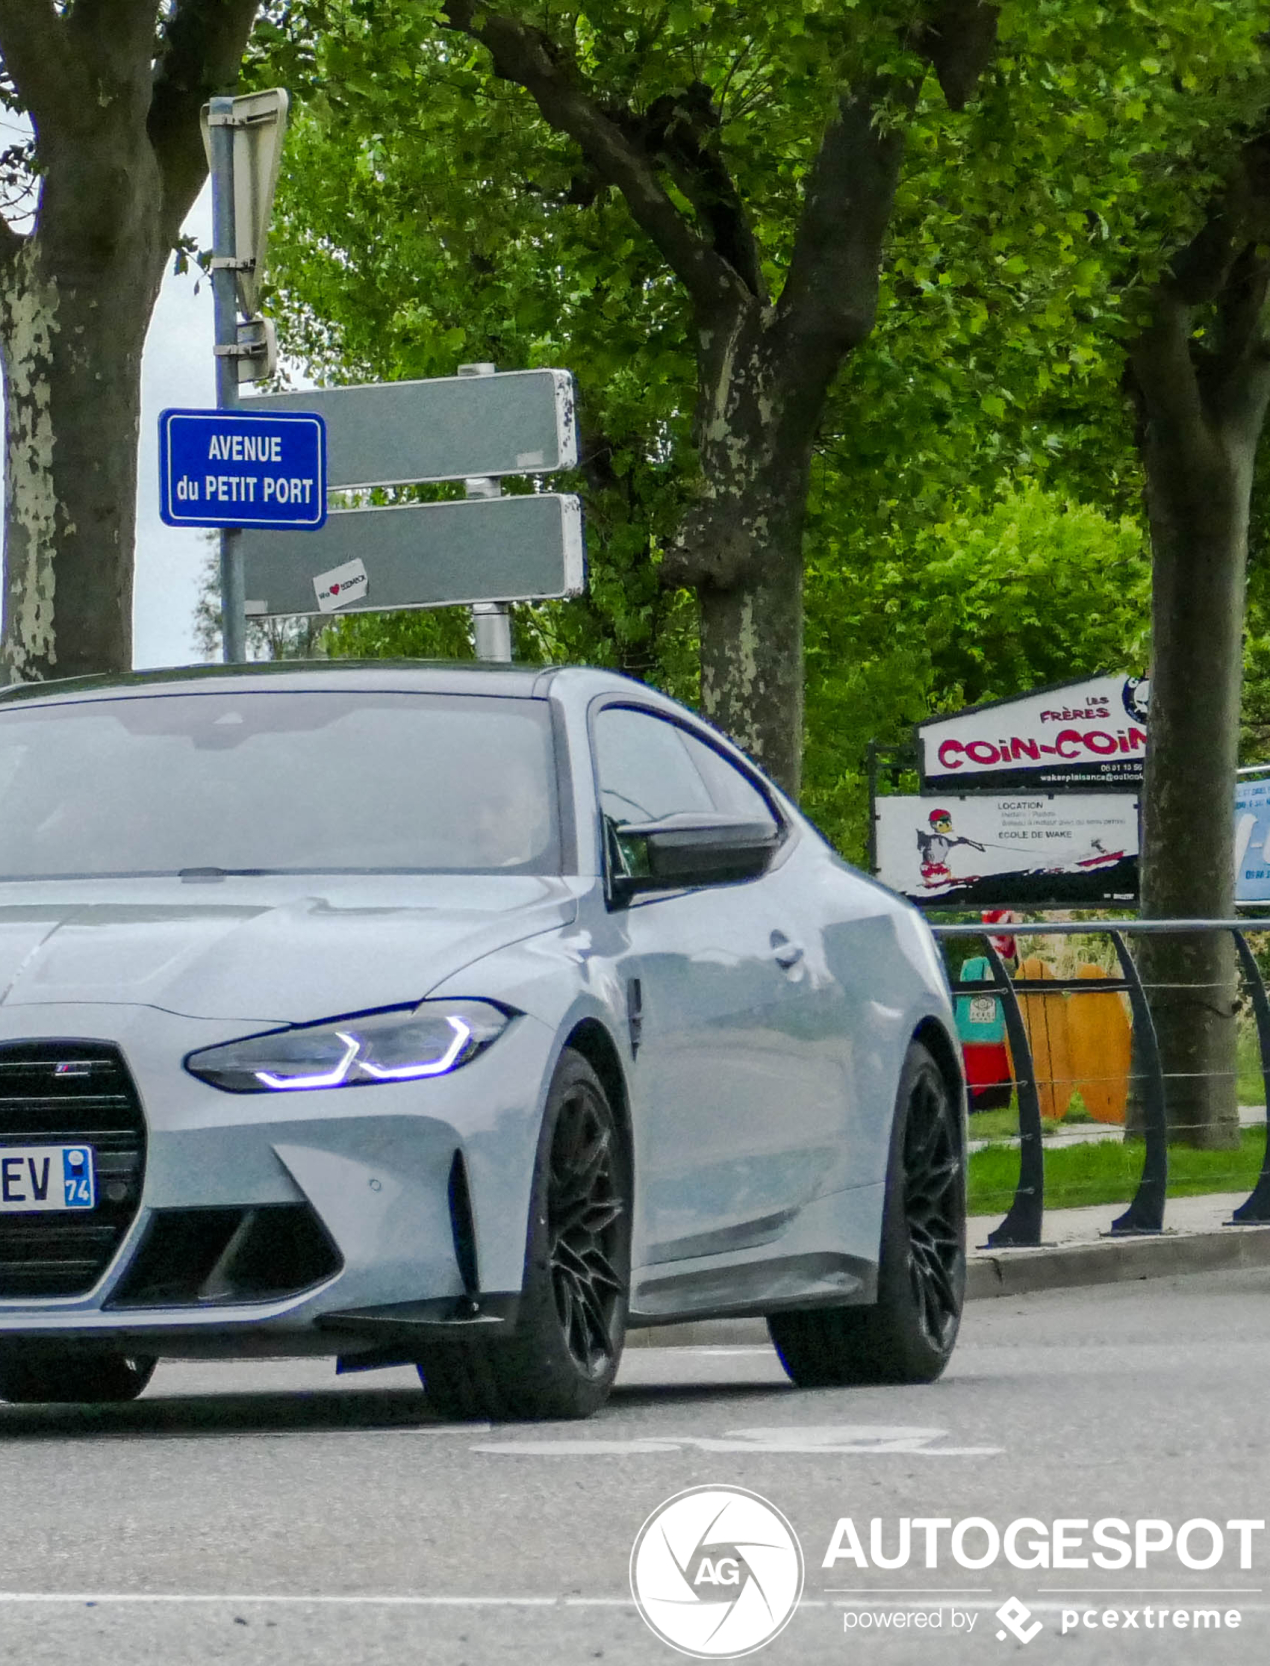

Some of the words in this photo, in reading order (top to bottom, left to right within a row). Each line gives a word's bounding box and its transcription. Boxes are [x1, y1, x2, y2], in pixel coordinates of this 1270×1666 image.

[208, 435, 282, 462] AVENUE
[177, 475, 199, 500] du
[205, 475, 257, 502] PETIT
[263, 477, 314, 503] PORT
[1040, 706, 1111, 723] FRÈRES
[998, 802, 1043, 810] LOCATION
[1031, 831, 1043, 839] DE
[1045, 831, 1073, 839] WAKE
[66, 1180, 90, 1201] 74
